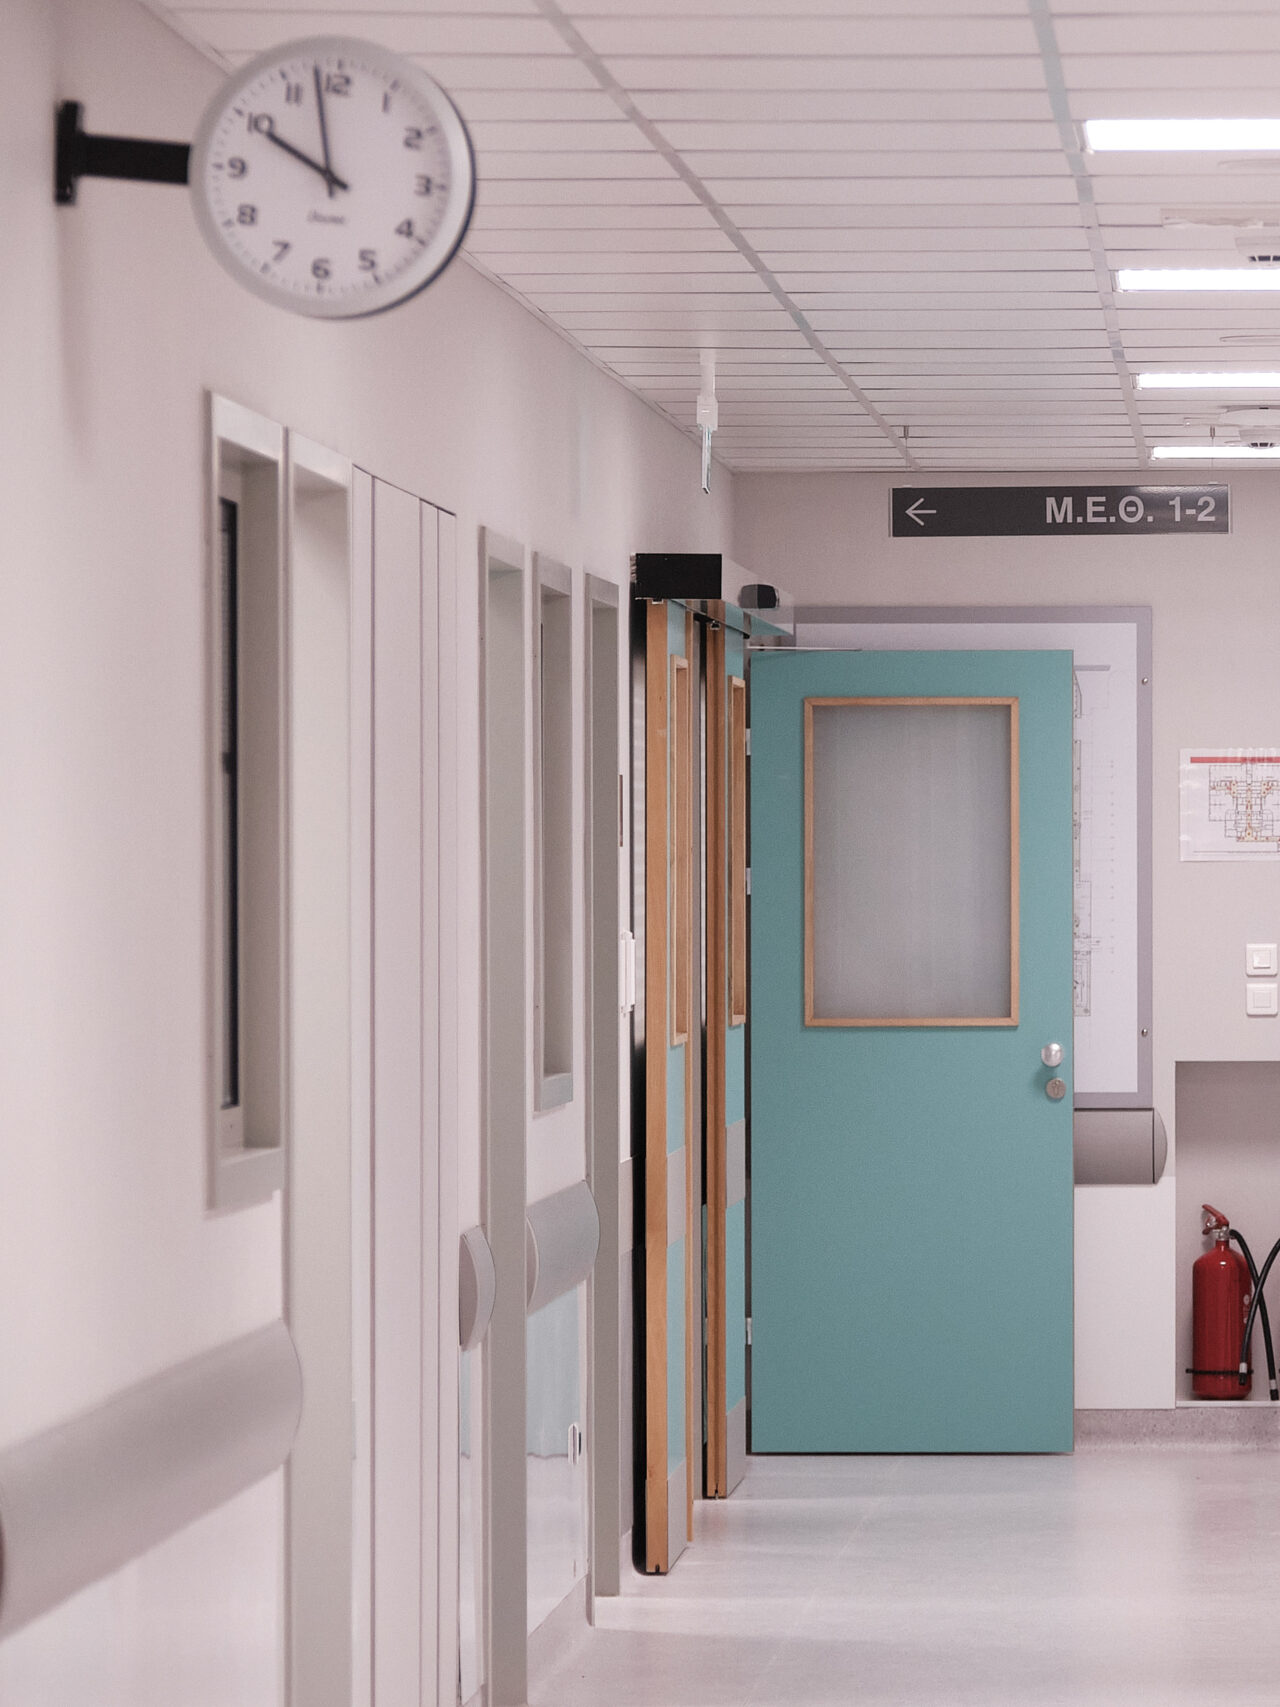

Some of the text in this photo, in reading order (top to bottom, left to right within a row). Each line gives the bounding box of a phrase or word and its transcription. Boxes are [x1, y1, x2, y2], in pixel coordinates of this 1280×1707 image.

[286, 84, 301, 104] 11
[326, 74, 350, 96] 12
[382, 92, 390, 113] 1
[247, 113, 274, 134] 10
[403, 127, 423, 150] 2
[227, 157, 247, 179] 9
[415, 175, 432, 196] 3
[238, 204, 257, 226] 8
[394, 218, 414, 238] 4
[273, 240, 291, 262] 7
[358, 249, 377, 271] 5
[311, 258, 331, 279] 6
[1168, 496, 1216, 522] 1-2
